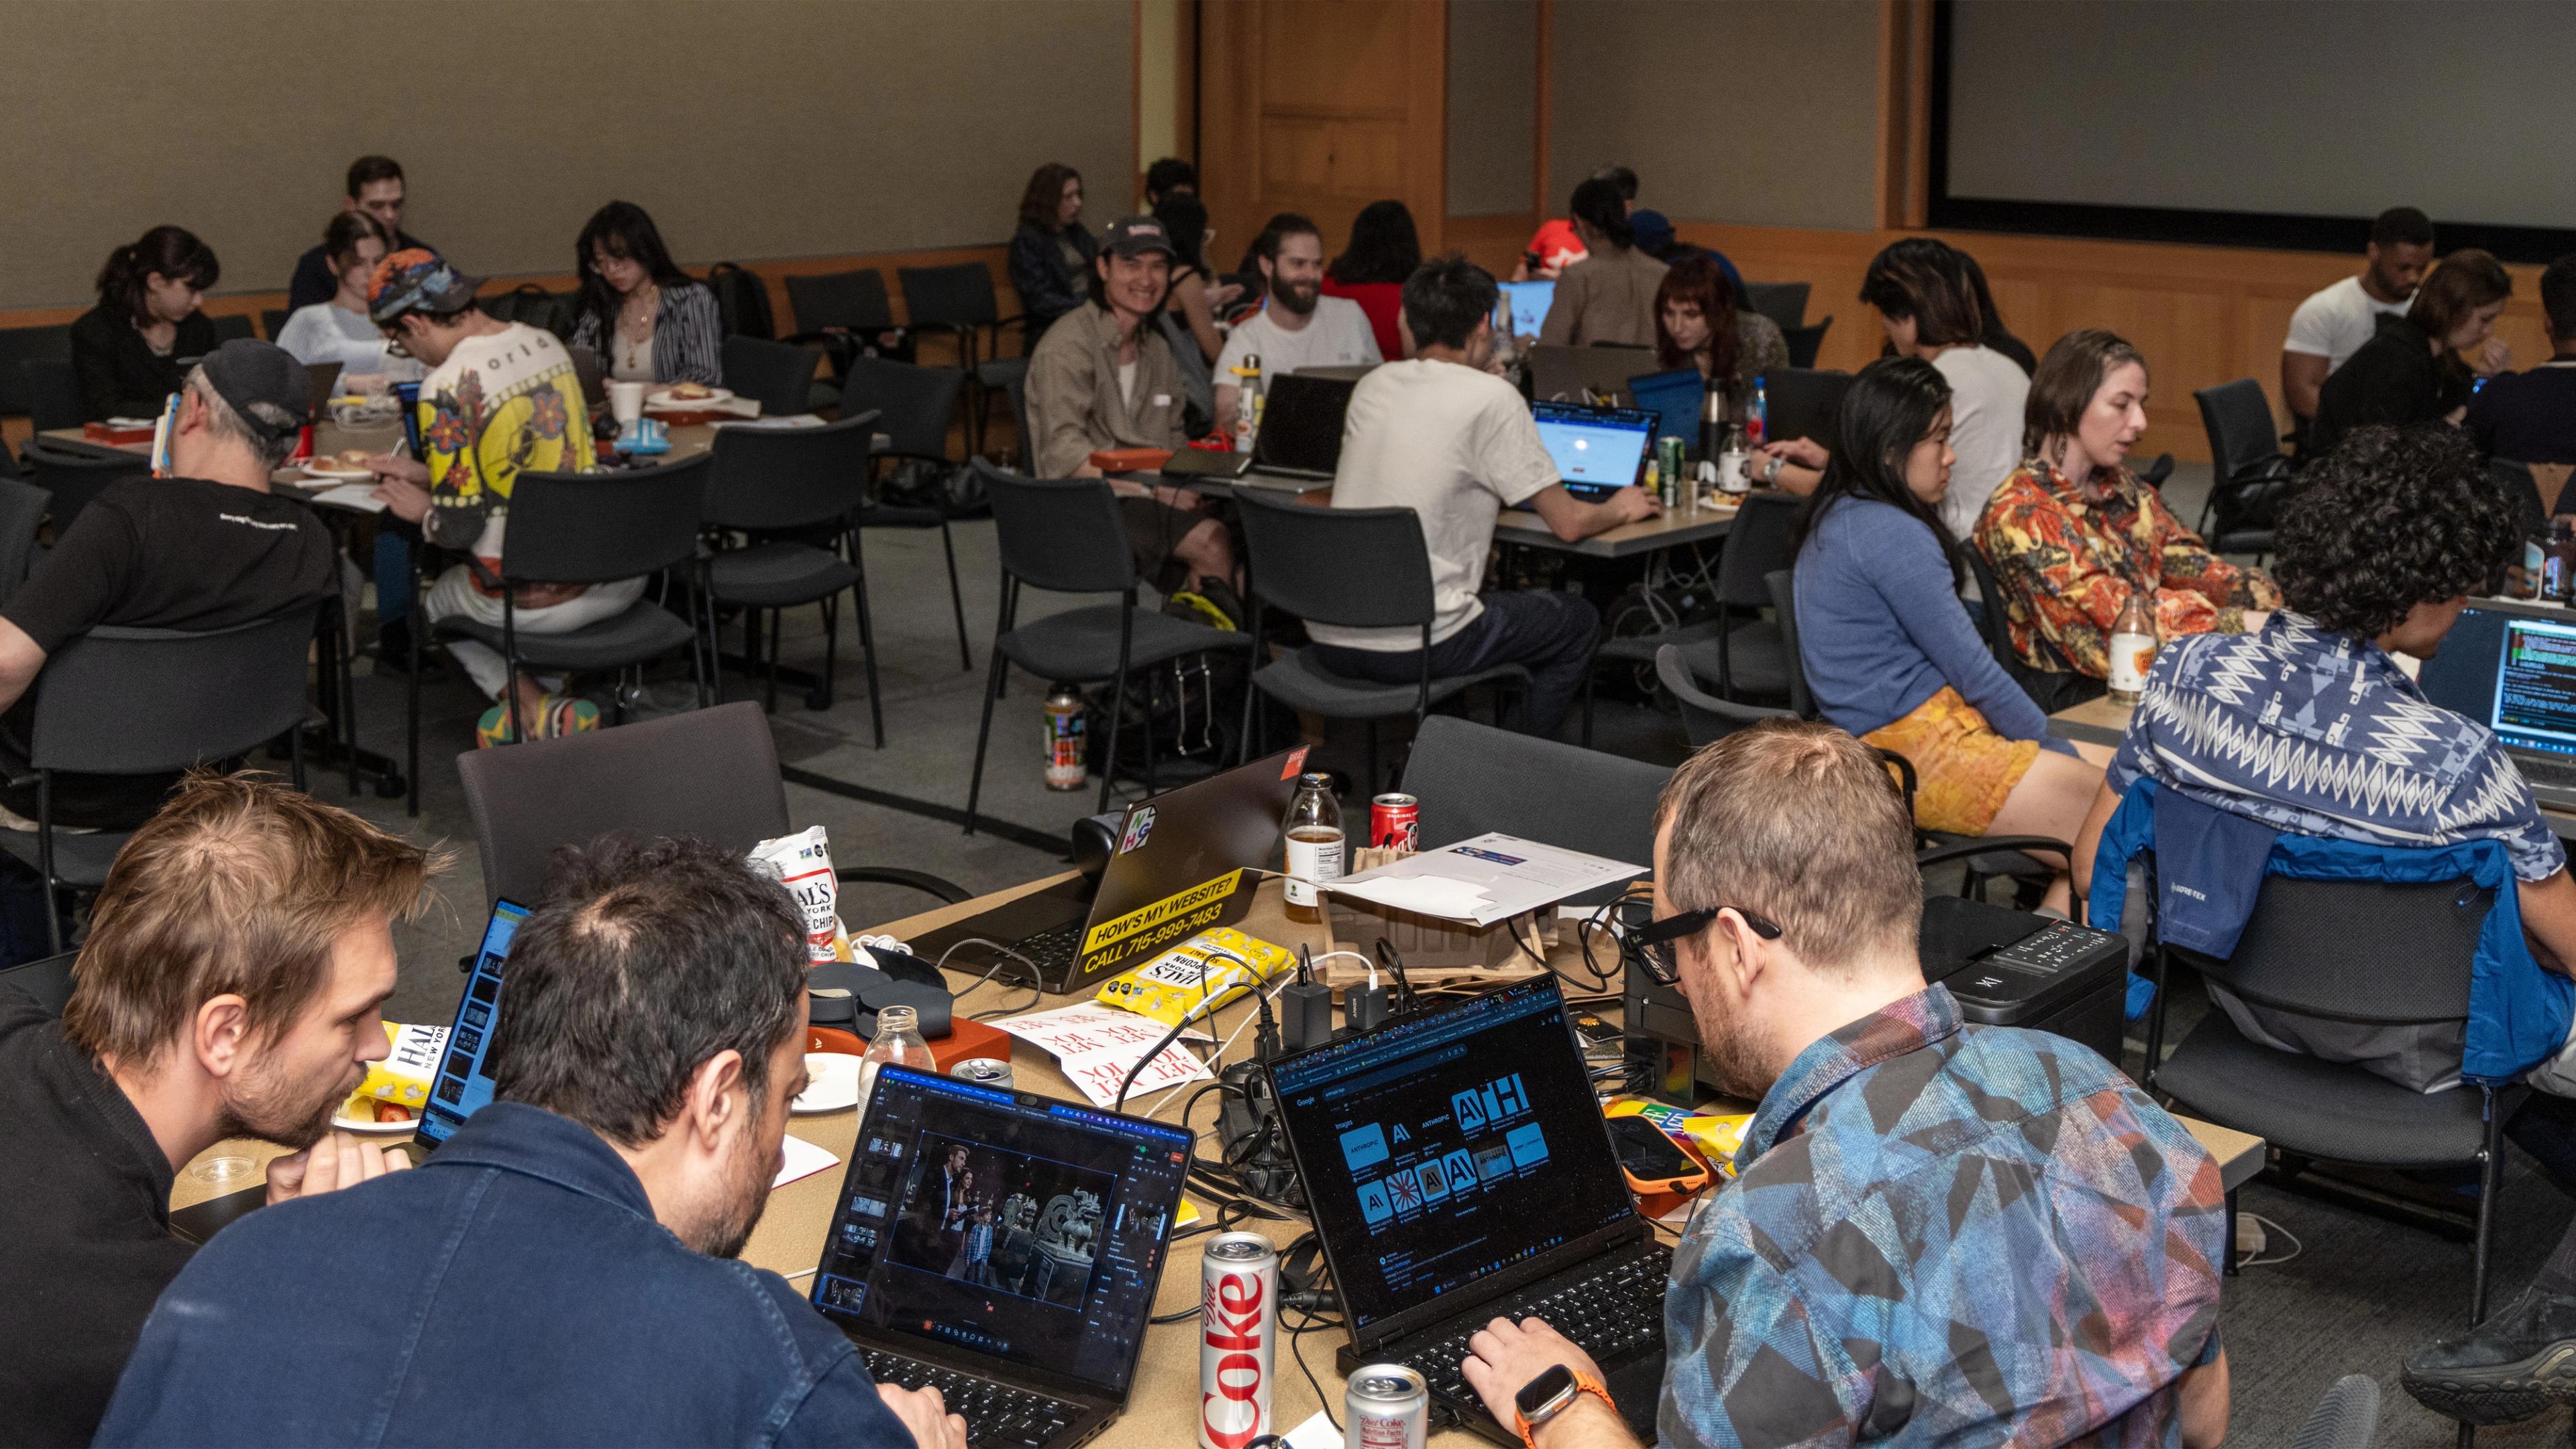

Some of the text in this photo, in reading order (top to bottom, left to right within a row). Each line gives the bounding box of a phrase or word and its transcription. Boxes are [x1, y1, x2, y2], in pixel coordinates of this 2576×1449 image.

[798, 882, 830, 906] AL'S
[2176, 885, 2206, 902] GORE-TEX
[1095, 877, 1232, 944] HOW'S MY WEBSITE?
[1084, 903, 1222, 973] CALL 715-999-7483
[1150, 965, 1201, 985] HAL'S
[397, 1026, 437, 1067] HAL
[424, 1026, 445, 1069] NEW YOR
[1152, 1060, 1198, 1079] MET
[1297, 1096, 1315, 1106] Google
[1335, 1120, 1353, 1130] Images
[1422, 1114, 1450, 1128] ANTHROPIC
[1351, 1140, 1379, 1154] ANTHROPIC
[1203, 1279, 1216, 1328] Diet
[1203, 1273, 1263, 1449] Coke
[1359, 1415, 1405, 1427] Diet Coke
[1362, 1427, 1385, 1436] Nutrition
